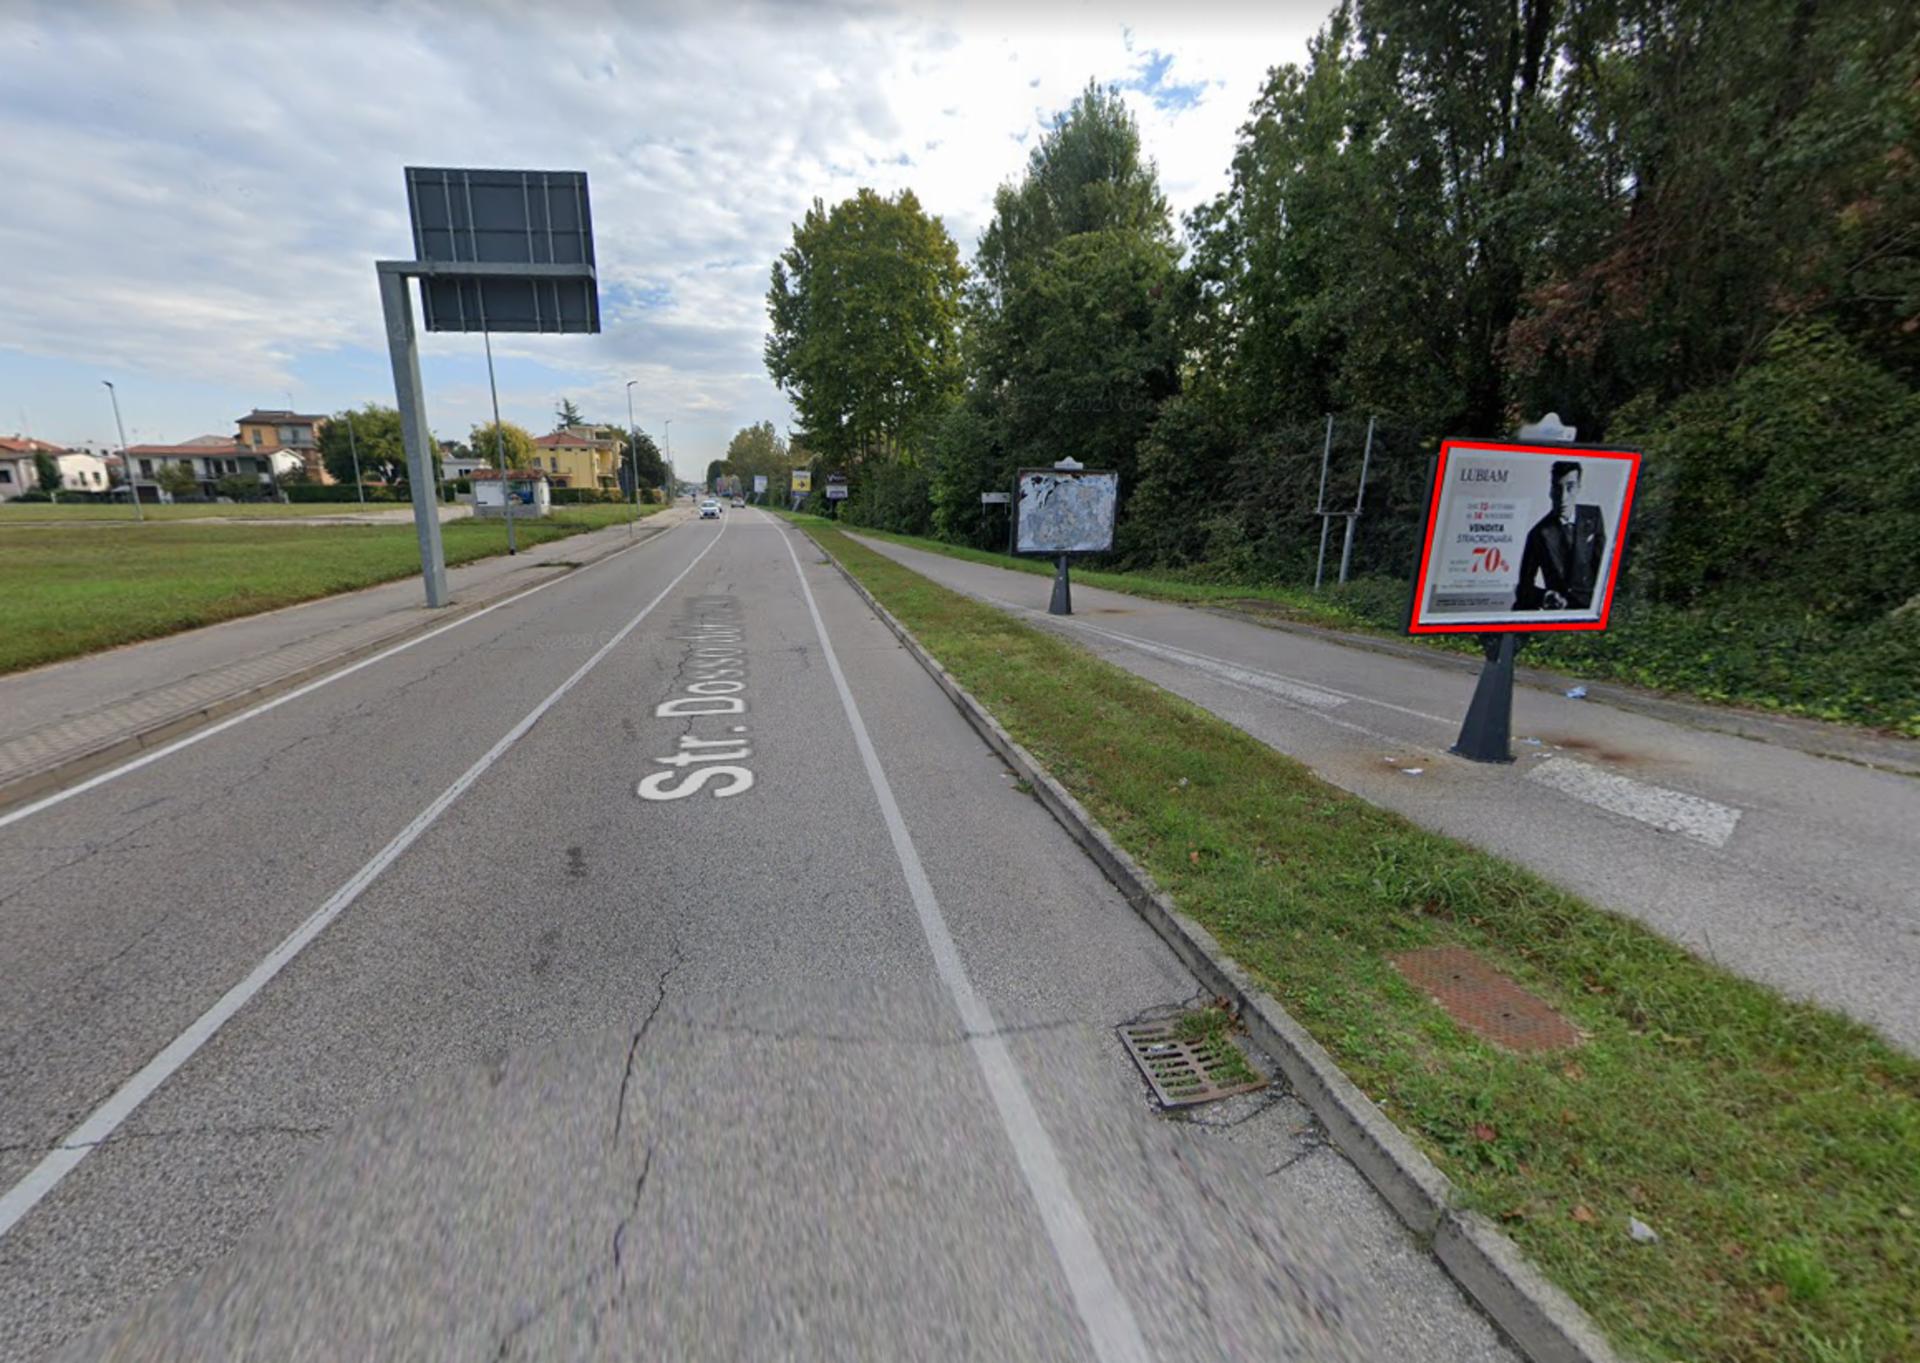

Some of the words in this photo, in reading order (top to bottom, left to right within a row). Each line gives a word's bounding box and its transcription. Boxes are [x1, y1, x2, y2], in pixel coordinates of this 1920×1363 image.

[1460, 467, 1509, 482] LUBIAM
[1469, 523, 1504, 532] VENDITA
[1456, 533, 1513, 544] STRAORDINARIA
[1472, 546, 1510, 574] 70%
